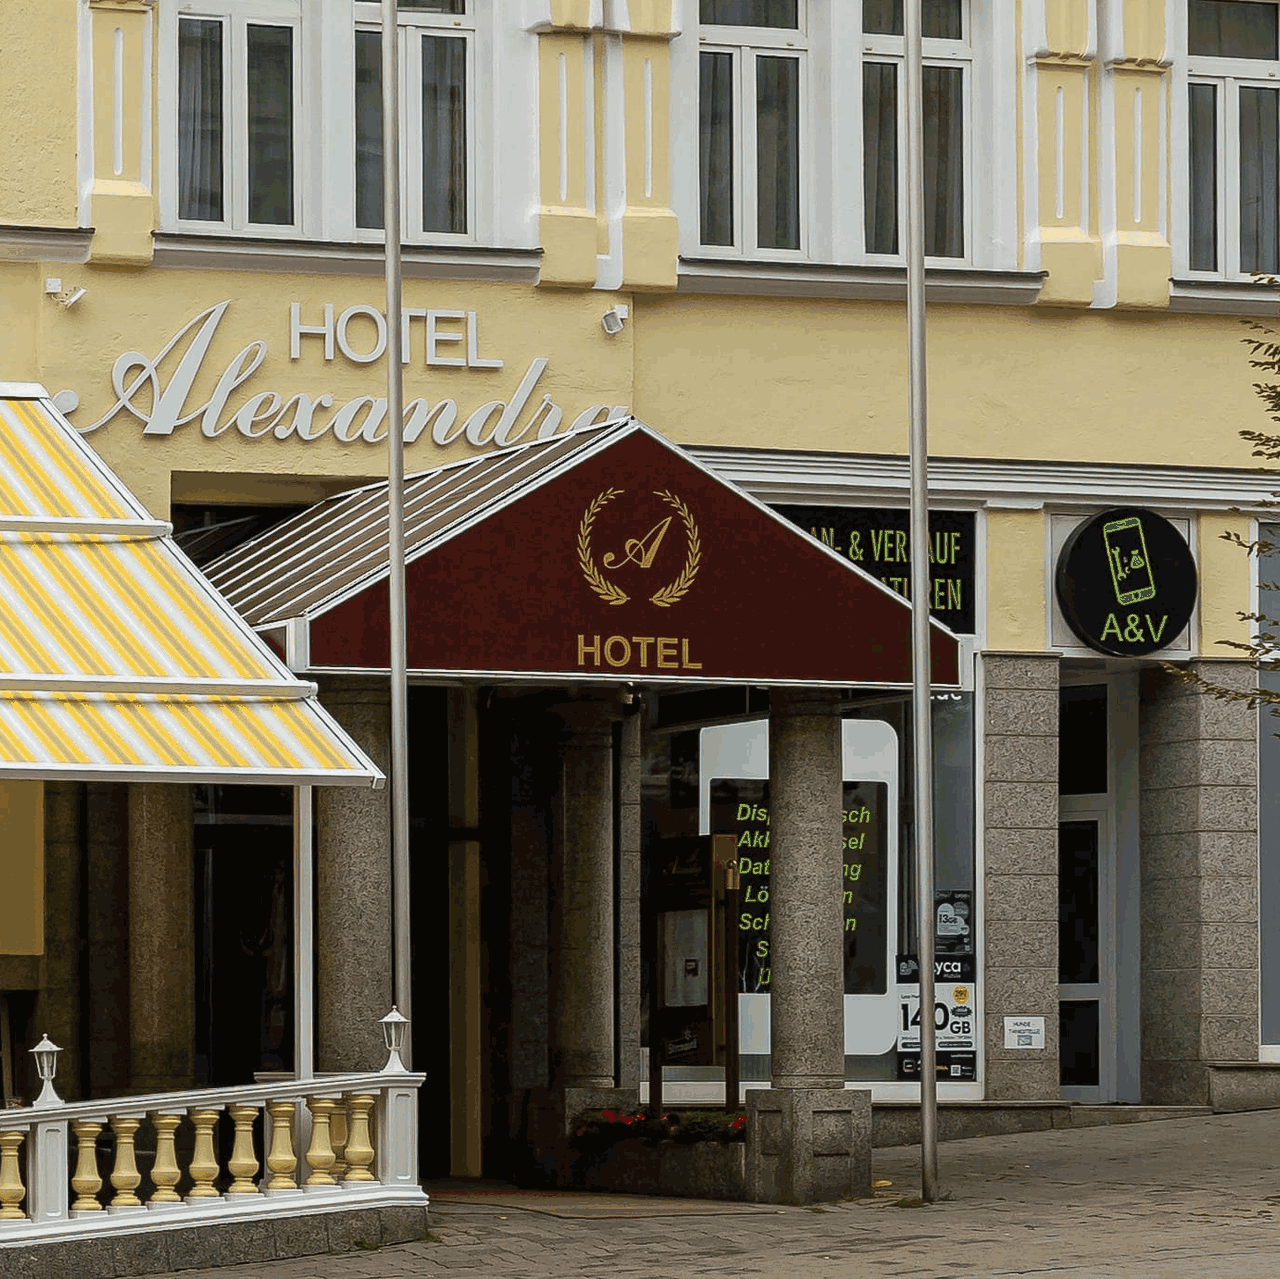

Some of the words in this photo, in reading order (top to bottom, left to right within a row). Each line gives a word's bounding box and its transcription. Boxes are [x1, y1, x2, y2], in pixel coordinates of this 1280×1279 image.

[290, 302, 504, 368] HOTEL
[849, 531, 864, 561] &
[871, 530, 961, 564] VERAUF
[1100, 613, 1168, 643] A&V
[578, 635, 702, 669] HOTEL
[934, 961, 961, 975] yca
[949, 1020, 971, 1034] GB
